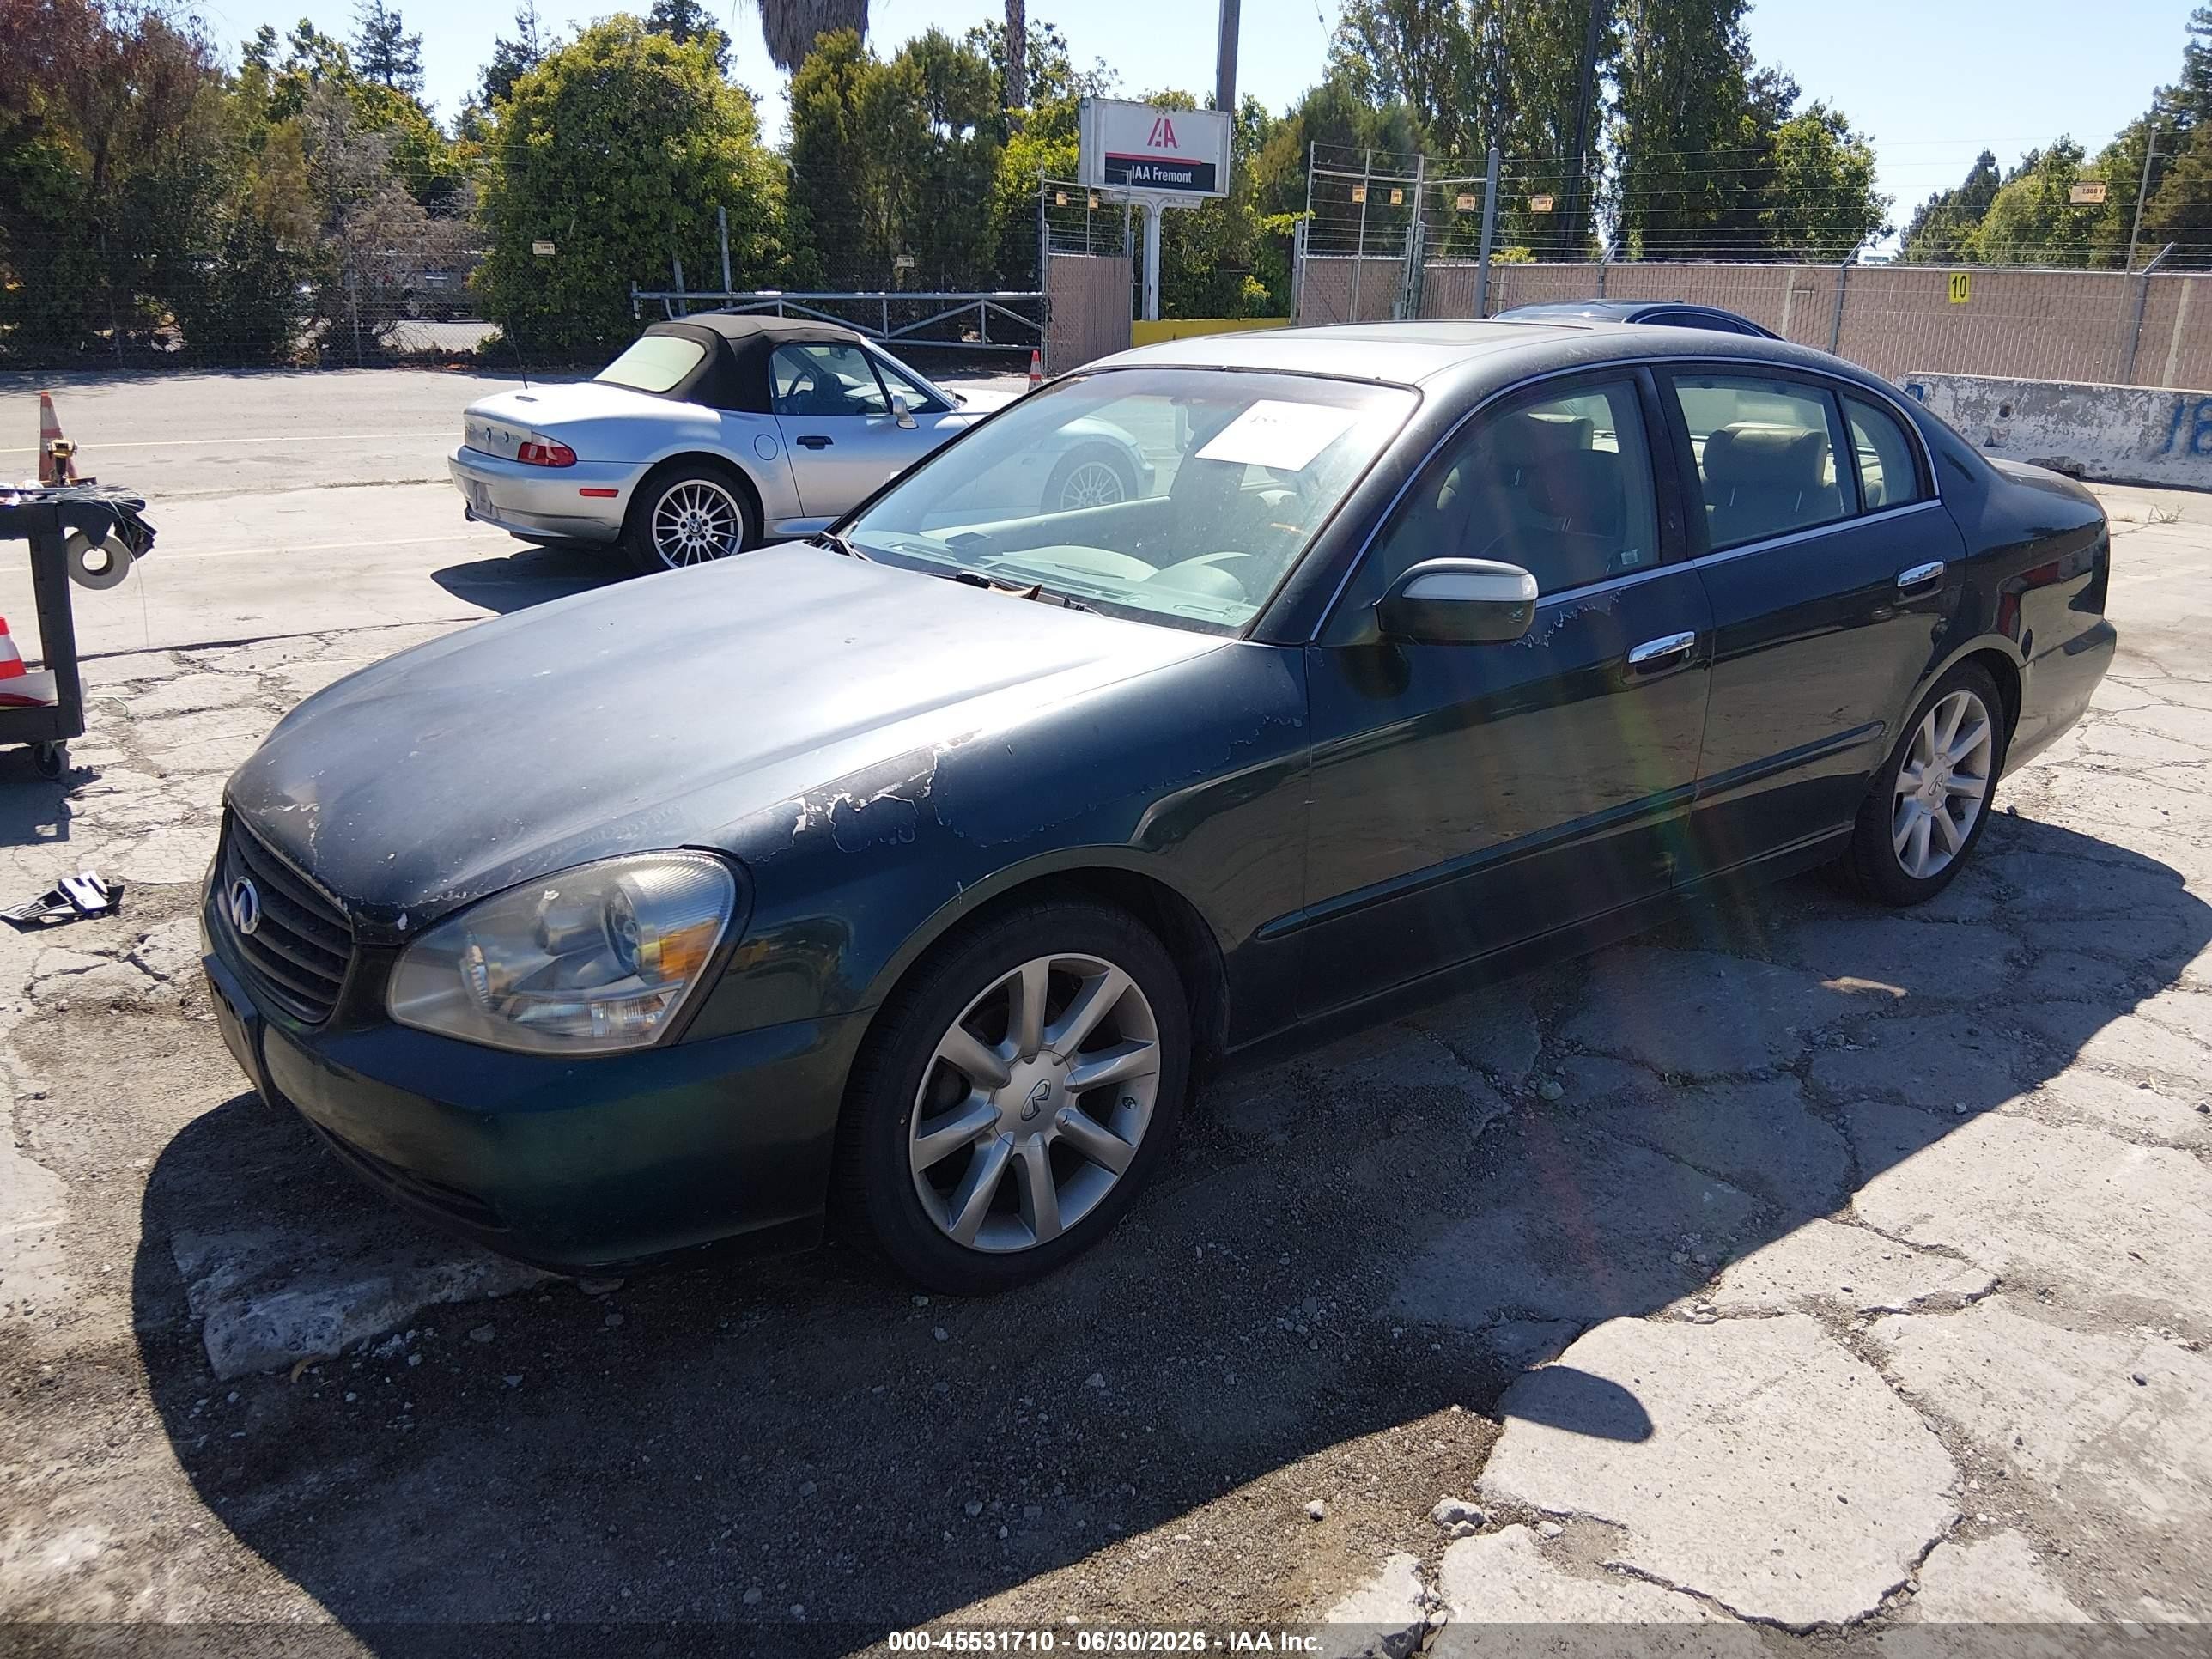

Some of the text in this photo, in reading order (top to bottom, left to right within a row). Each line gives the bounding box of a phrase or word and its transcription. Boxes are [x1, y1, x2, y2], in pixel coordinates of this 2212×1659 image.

[1132, 165, 1192, 183] IAA Fremont
[1952, 275, 1967, 298] 10
